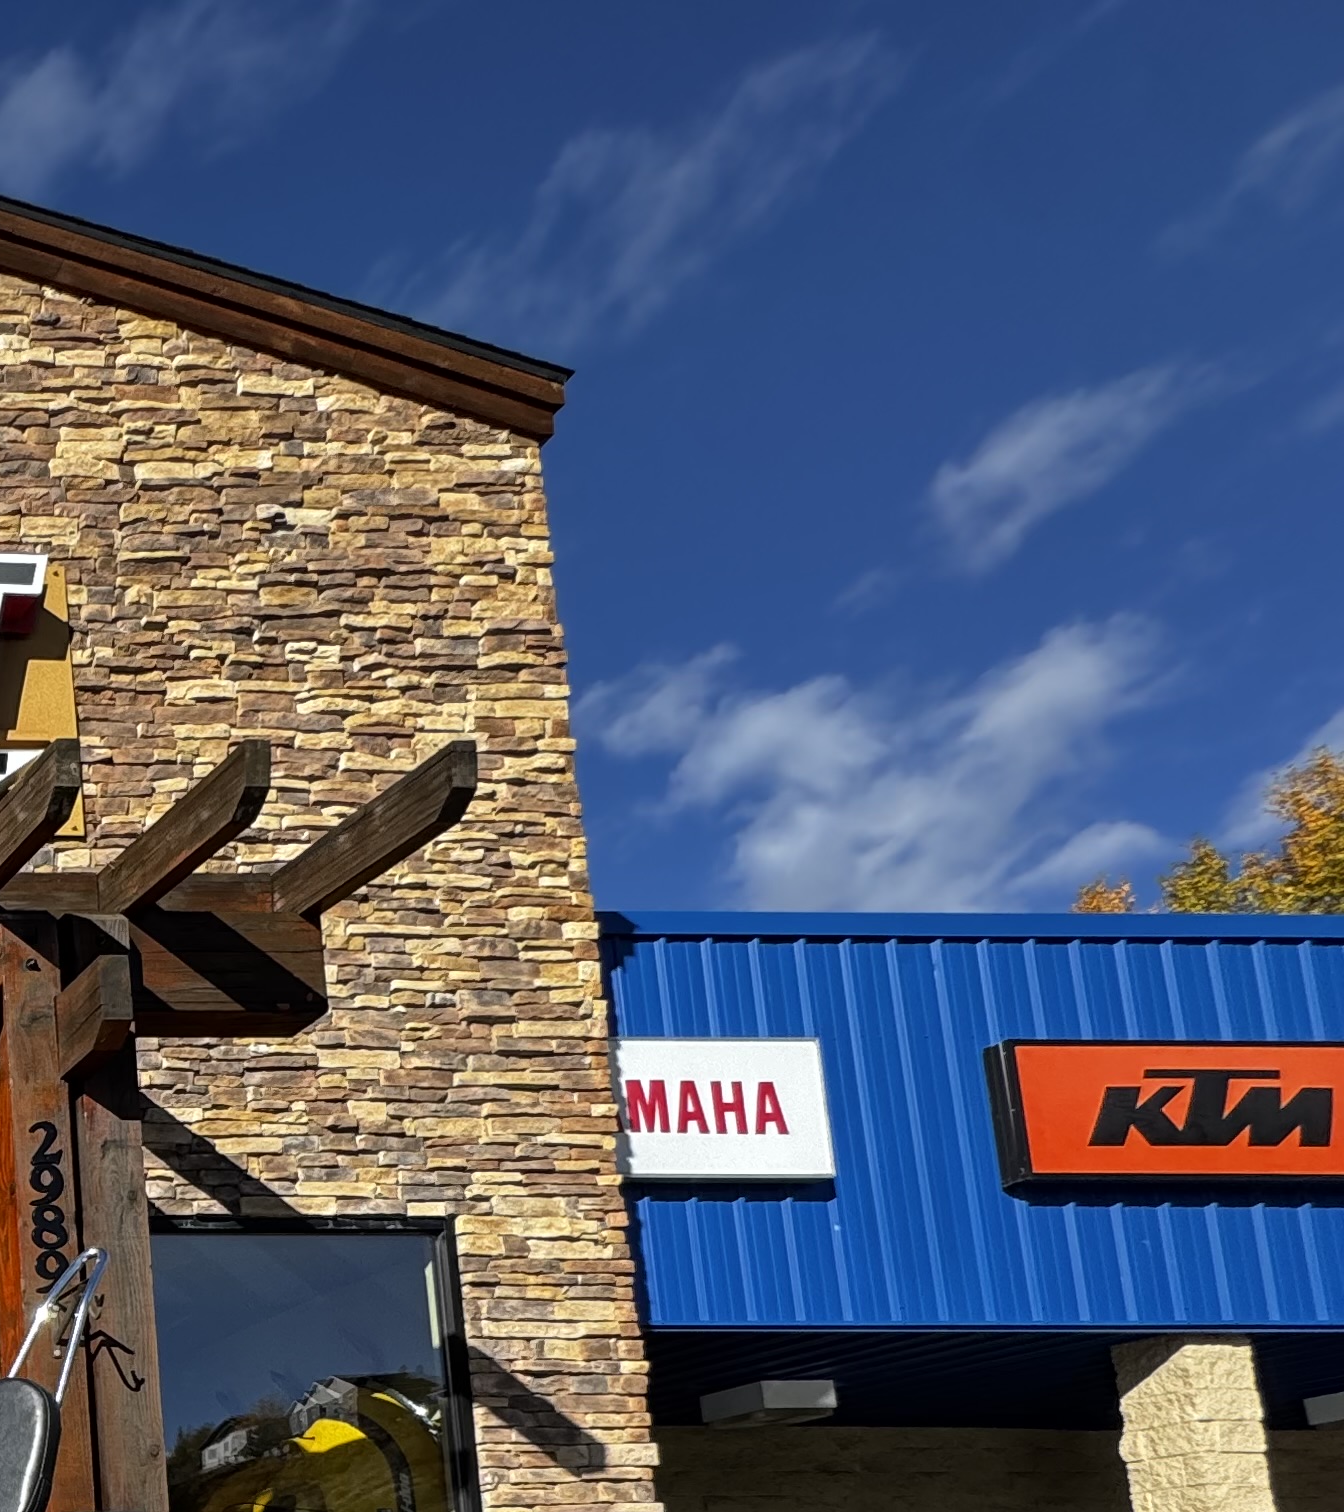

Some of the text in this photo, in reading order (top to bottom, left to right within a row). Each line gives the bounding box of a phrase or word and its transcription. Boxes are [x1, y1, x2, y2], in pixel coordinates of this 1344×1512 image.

[625, 1079, 790, 1135] MAHA
[1087, 1068, 1334, 1148] KTM
[28, 1120, 69, 1294] 2989
